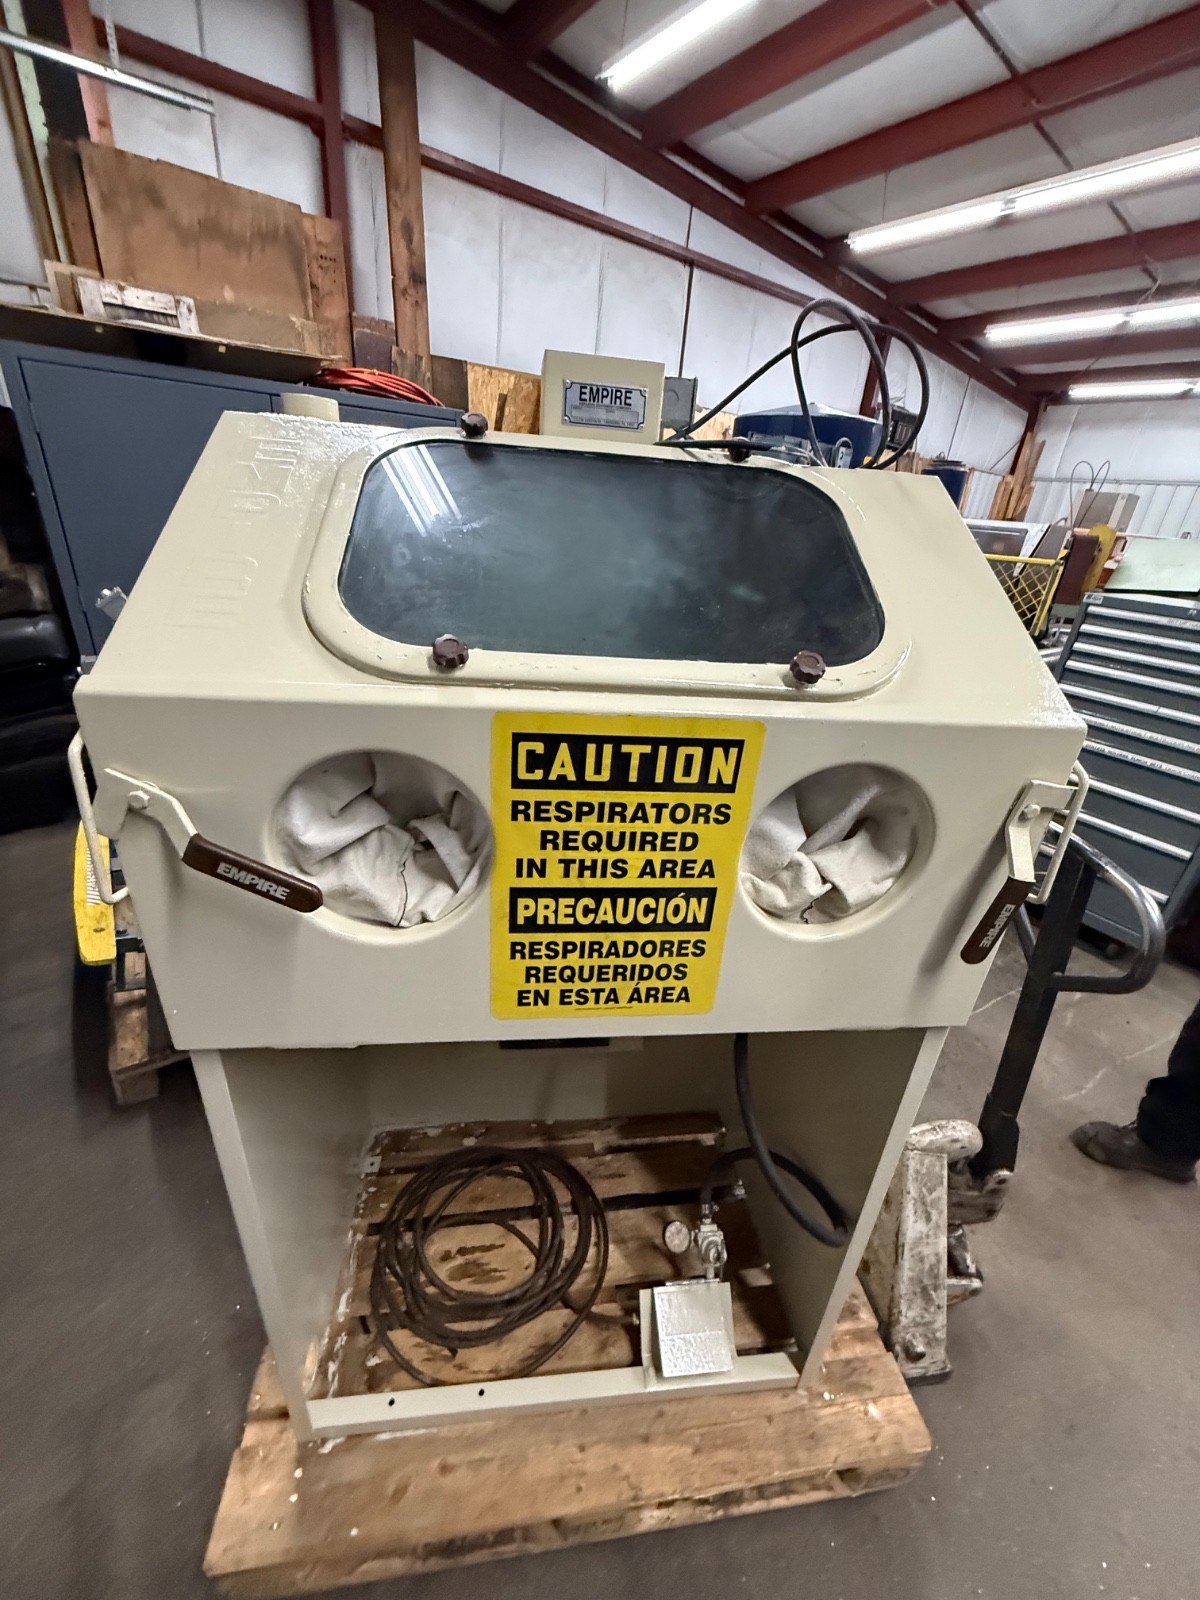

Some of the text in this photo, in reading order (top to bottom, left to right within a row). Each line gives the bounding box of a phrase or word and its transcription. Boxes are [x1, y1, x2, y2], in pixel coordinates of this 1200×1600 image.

[579, 386, 633, 406] EMPIRE
[517, 741, 739, 785] CAUTION
[511, 800, 732, 825] RESPIRATORS
[540, 830, 699, 853] REQUIRED
[515, 858, 715, 879] IN THIS AREA
[217, 862, 290, 900] EMPIRE
[517, 893, 709, 925] PRECAUCIÓN
[979, 904, 1016, 948] EMPIRE
[509, 939, 707, 960] RESPIRADORES
[525, 963, 688, 983] REQUERIDOS
[517, 982, 691, 1006] EN ESTA ÁREA
